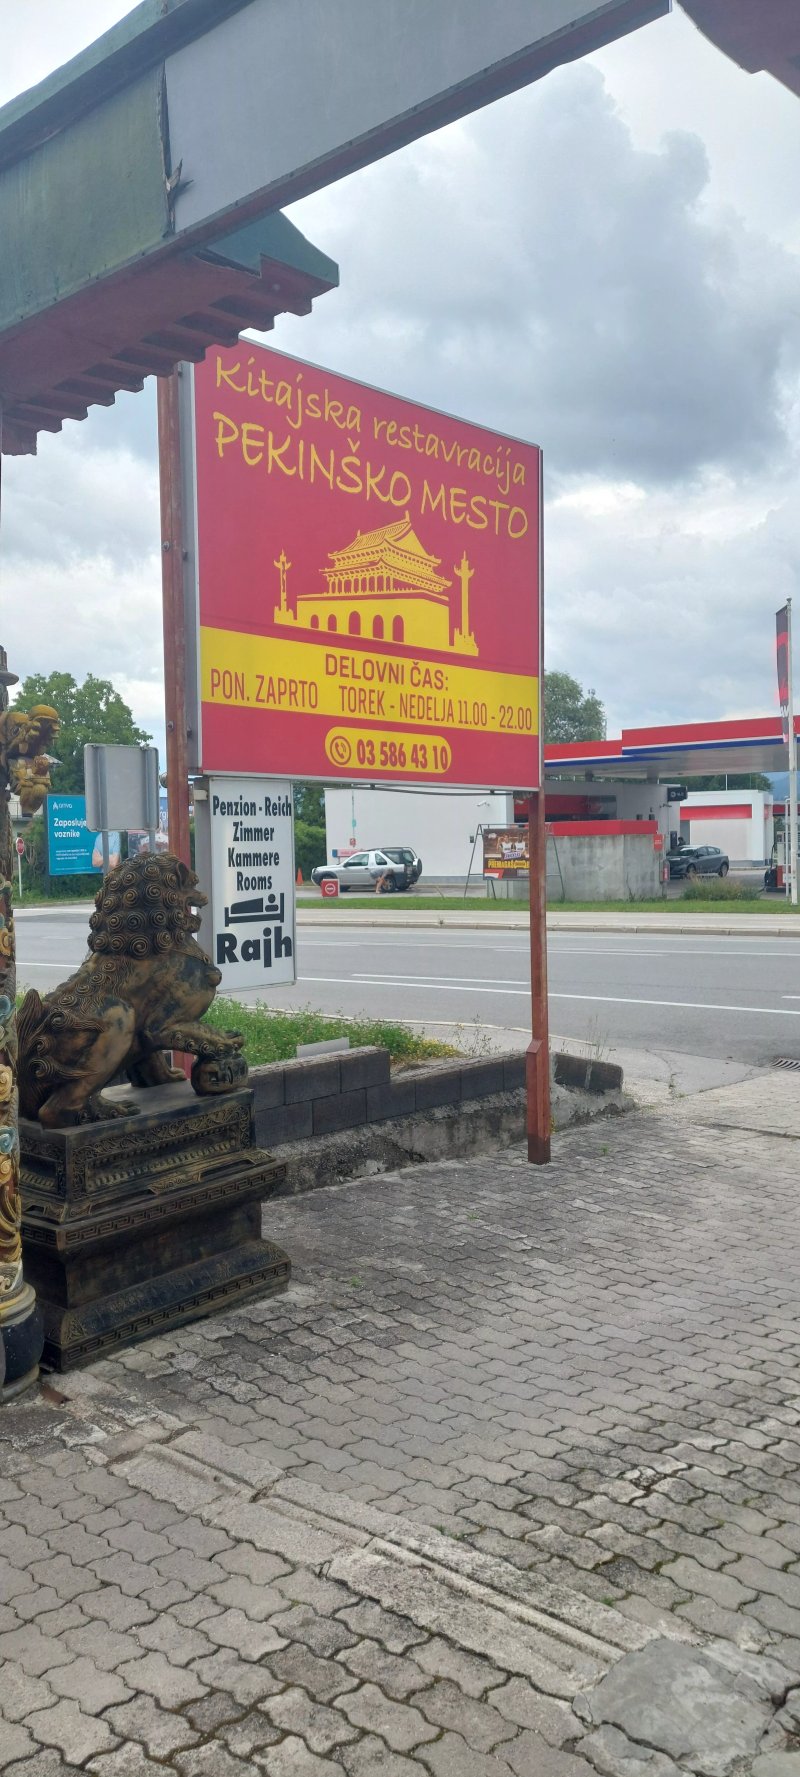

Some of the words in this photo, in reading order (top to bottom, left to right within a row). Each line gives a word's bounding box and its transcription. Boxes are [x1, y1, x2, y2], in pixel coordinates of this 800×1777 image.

[216, 356, 361, 430] Kitajska
[373, 417, 526, 494] restavracija
[213, 412, 412, 506] PEKINŠKO
[421, 480, 528, 539] MESTO
[210, 668, 250, 702] PON.
[255, 675, 319, 710] ZAPRTO
[325, 653, 405, 685] DELOVNI
[410, 660, 449, 691] ČAS:
[339, 685, 385, 716] TOREK
[399, 694, 454, 722] NEDELJA
[457, 702, 488, 726] 11.00
[499, 706, 533, 731] 22.00
[356, 739, 375, 764] 03
[379, 740, 407, 766] 586
[410, 744, 429, 769] 43
[432, 747, 449, 770] 10
[213, 795, 257, 816] Penzion
[265, 795, 292, 817] Reich
[233, 821, 274, 842] Zimmer
[228, 847, 279, 868] Kammere
[236, 871, 272, 891] Rooms
[216, 926, 292, 968] Rajh
